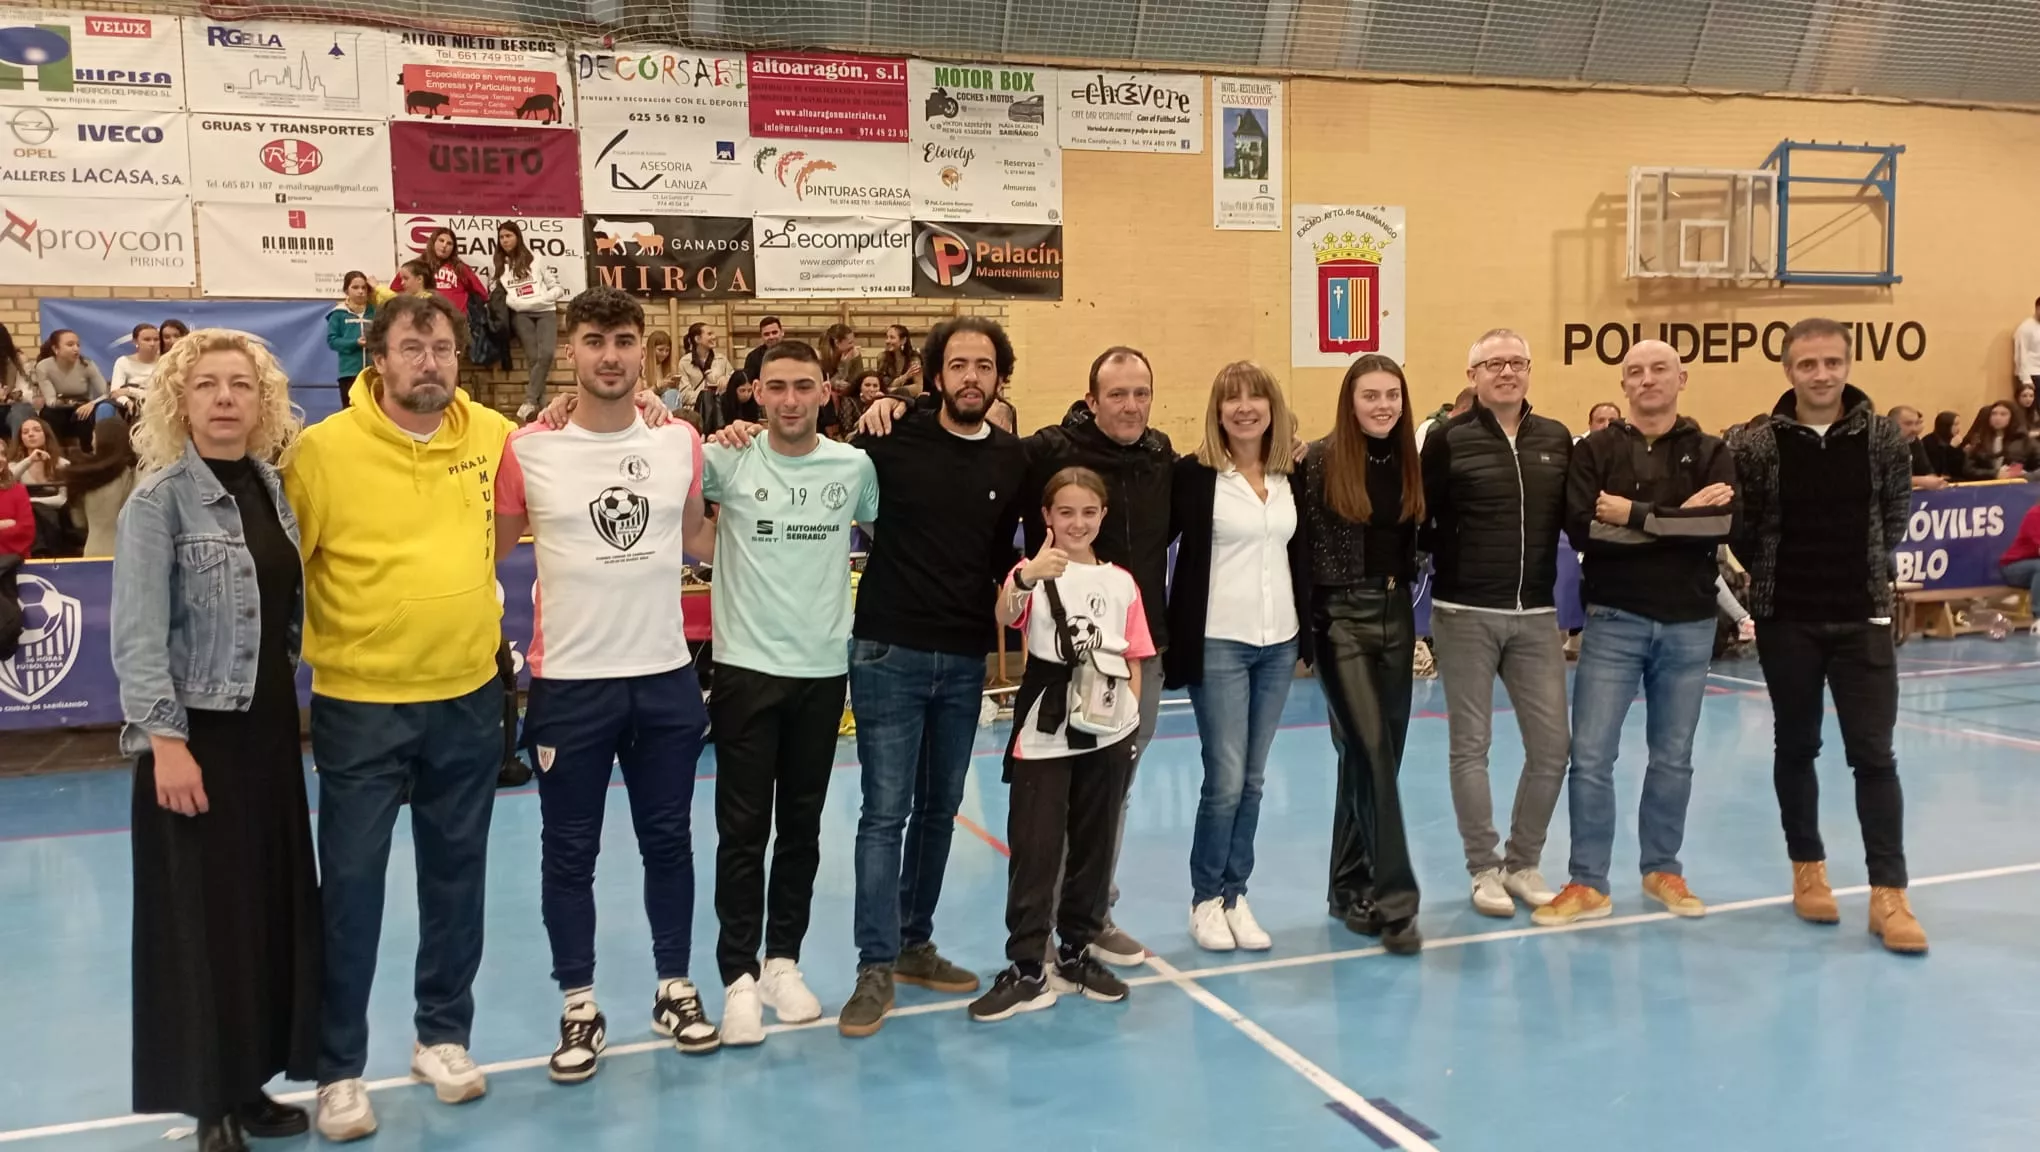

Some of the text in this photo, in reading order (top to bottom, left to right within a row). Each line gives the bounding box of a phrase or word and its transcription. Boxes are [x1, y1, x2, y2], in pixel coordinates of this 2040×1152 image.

[91, 21, 147, 35] VELUX
[207, 26, 283, 48] RGELA
[401, 32, 446, 48] AITOR
[452, 36, 495, 50] NIETO
[76, 69, 172, 84] HIPISA
[425, 70, 536, 84] Especializado en venta para
[935, 67, 1035, 92] MOTOR BOX
[426, 81, 467, 91] Empresas
[475, 82, 522, 92] Particulares
[675, 97, 693, 105] CON
[696, 98, 707, 106] EL
[709, 99, 749, 108] DEPORTE
[956, 92, 1014, 104] COCHES MOTOS
[629, 113, 706, 124] 625 56 82 10
[77, 124, 164, 143] IVECO
[202, 120, 375, 136] GRUAS Y TRANSPORTES
[13, 148, 58, 159] OPEL
[429, 145, 543, 176] USIETO
[640, 161, 692, 172] ASESORIA
[1003, 159, 1036, 168] Reservas
[0, 166, 65, 182] ALLERES
[72, 168, 159, 186] LACASA,
[664, 179, 708, 190] LANUZA
[805, 185, 911, 198] PINTURAS GRASA
[1011, 199, 1038, 208] Comidas
[37, 228, 183, 261] proycon
[671, 238, 750, 250] GANADOS
[798, 228, 911, 254] ecomputer
[976, 240, 1060, 265] Palacín
[130, 256, 184, 268] PIRINEO
[800, 258, 875, 267] www.ecomputer.es
[595, 265, 752, 292] MIRCA
[976, 266, 1060, 279] Mantenimiento
[1564, 321, 1927, 366] PODEPOIVO
[790, 488, 807, 506] 19
[786, 523, 840, 532] AUTOMÓVILES
[1902, 501, 2004, 542] ÓVILES
